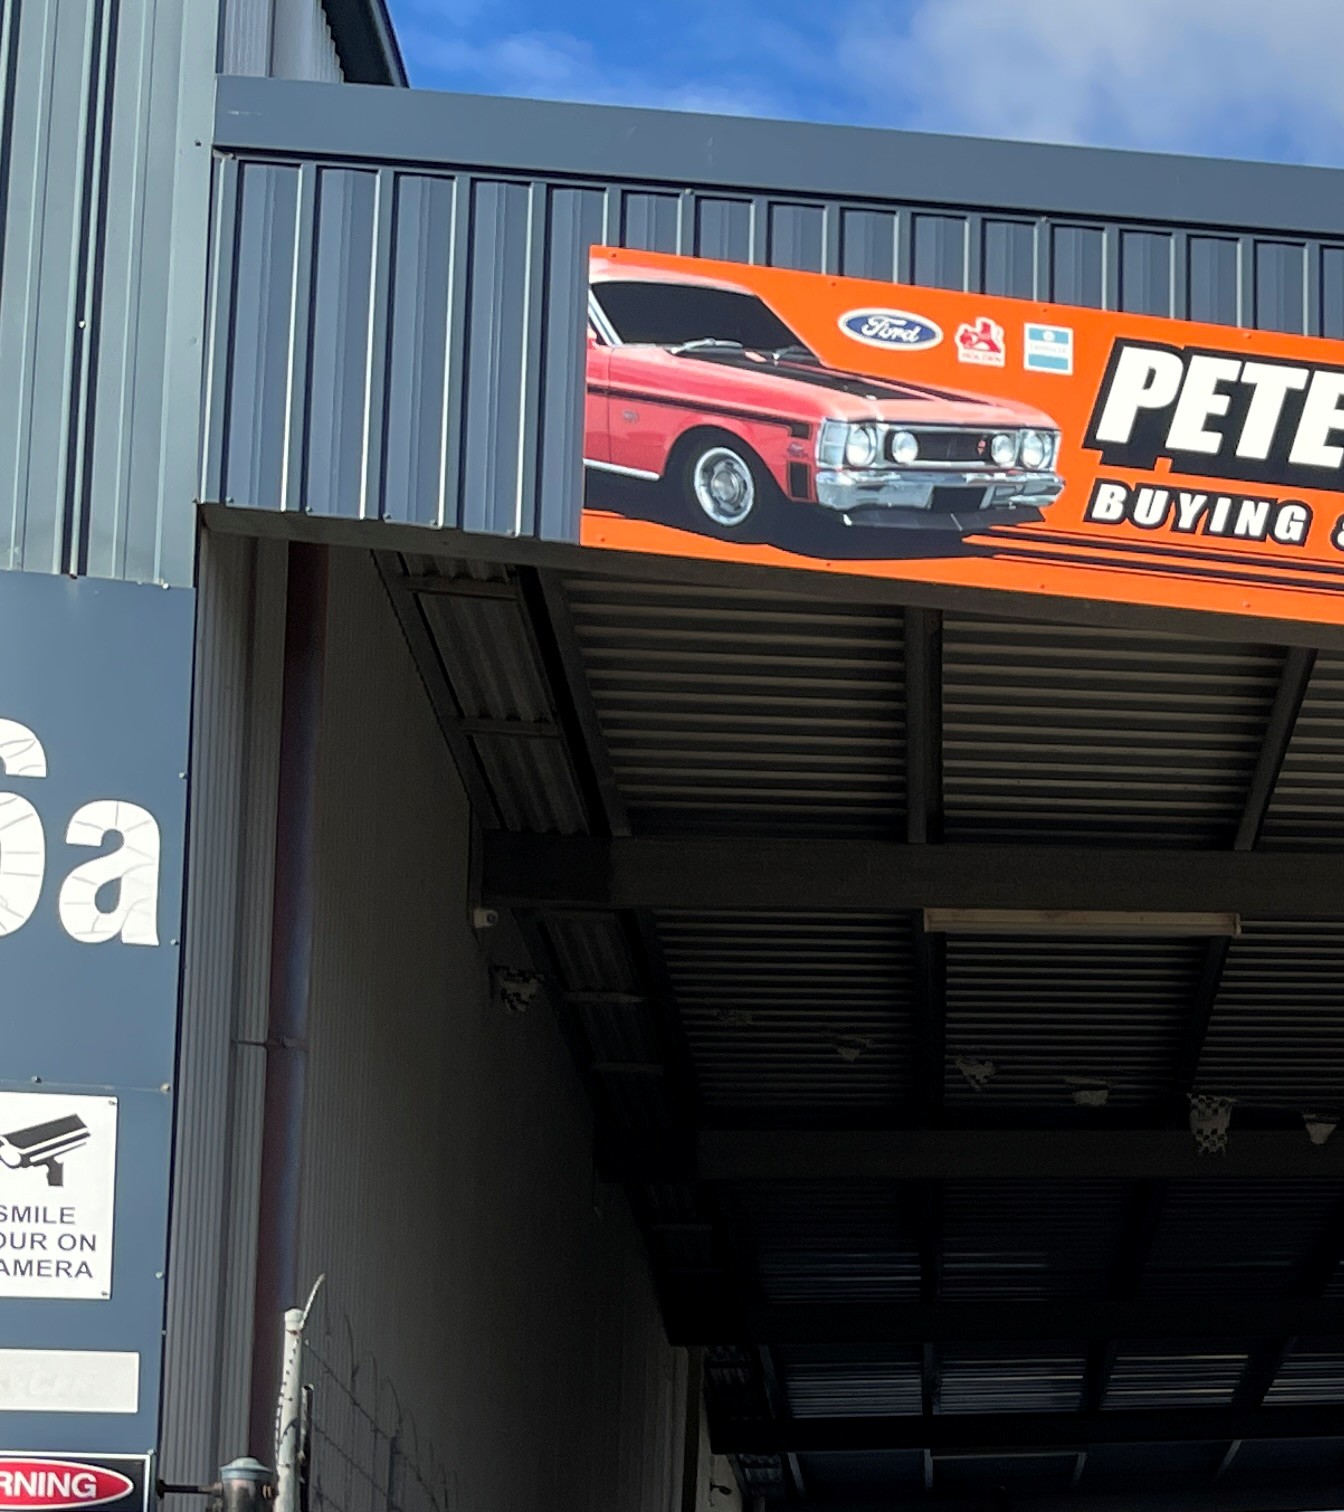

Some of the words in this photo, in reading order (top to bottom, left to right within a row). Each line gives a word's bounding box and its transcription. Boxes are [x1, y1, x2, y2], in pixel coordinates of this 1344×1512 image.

[861, 315, 921, 344] Ford
[1091, 483, 1307, 542] BUYING
[57, 1233, 97, 1252] ON
